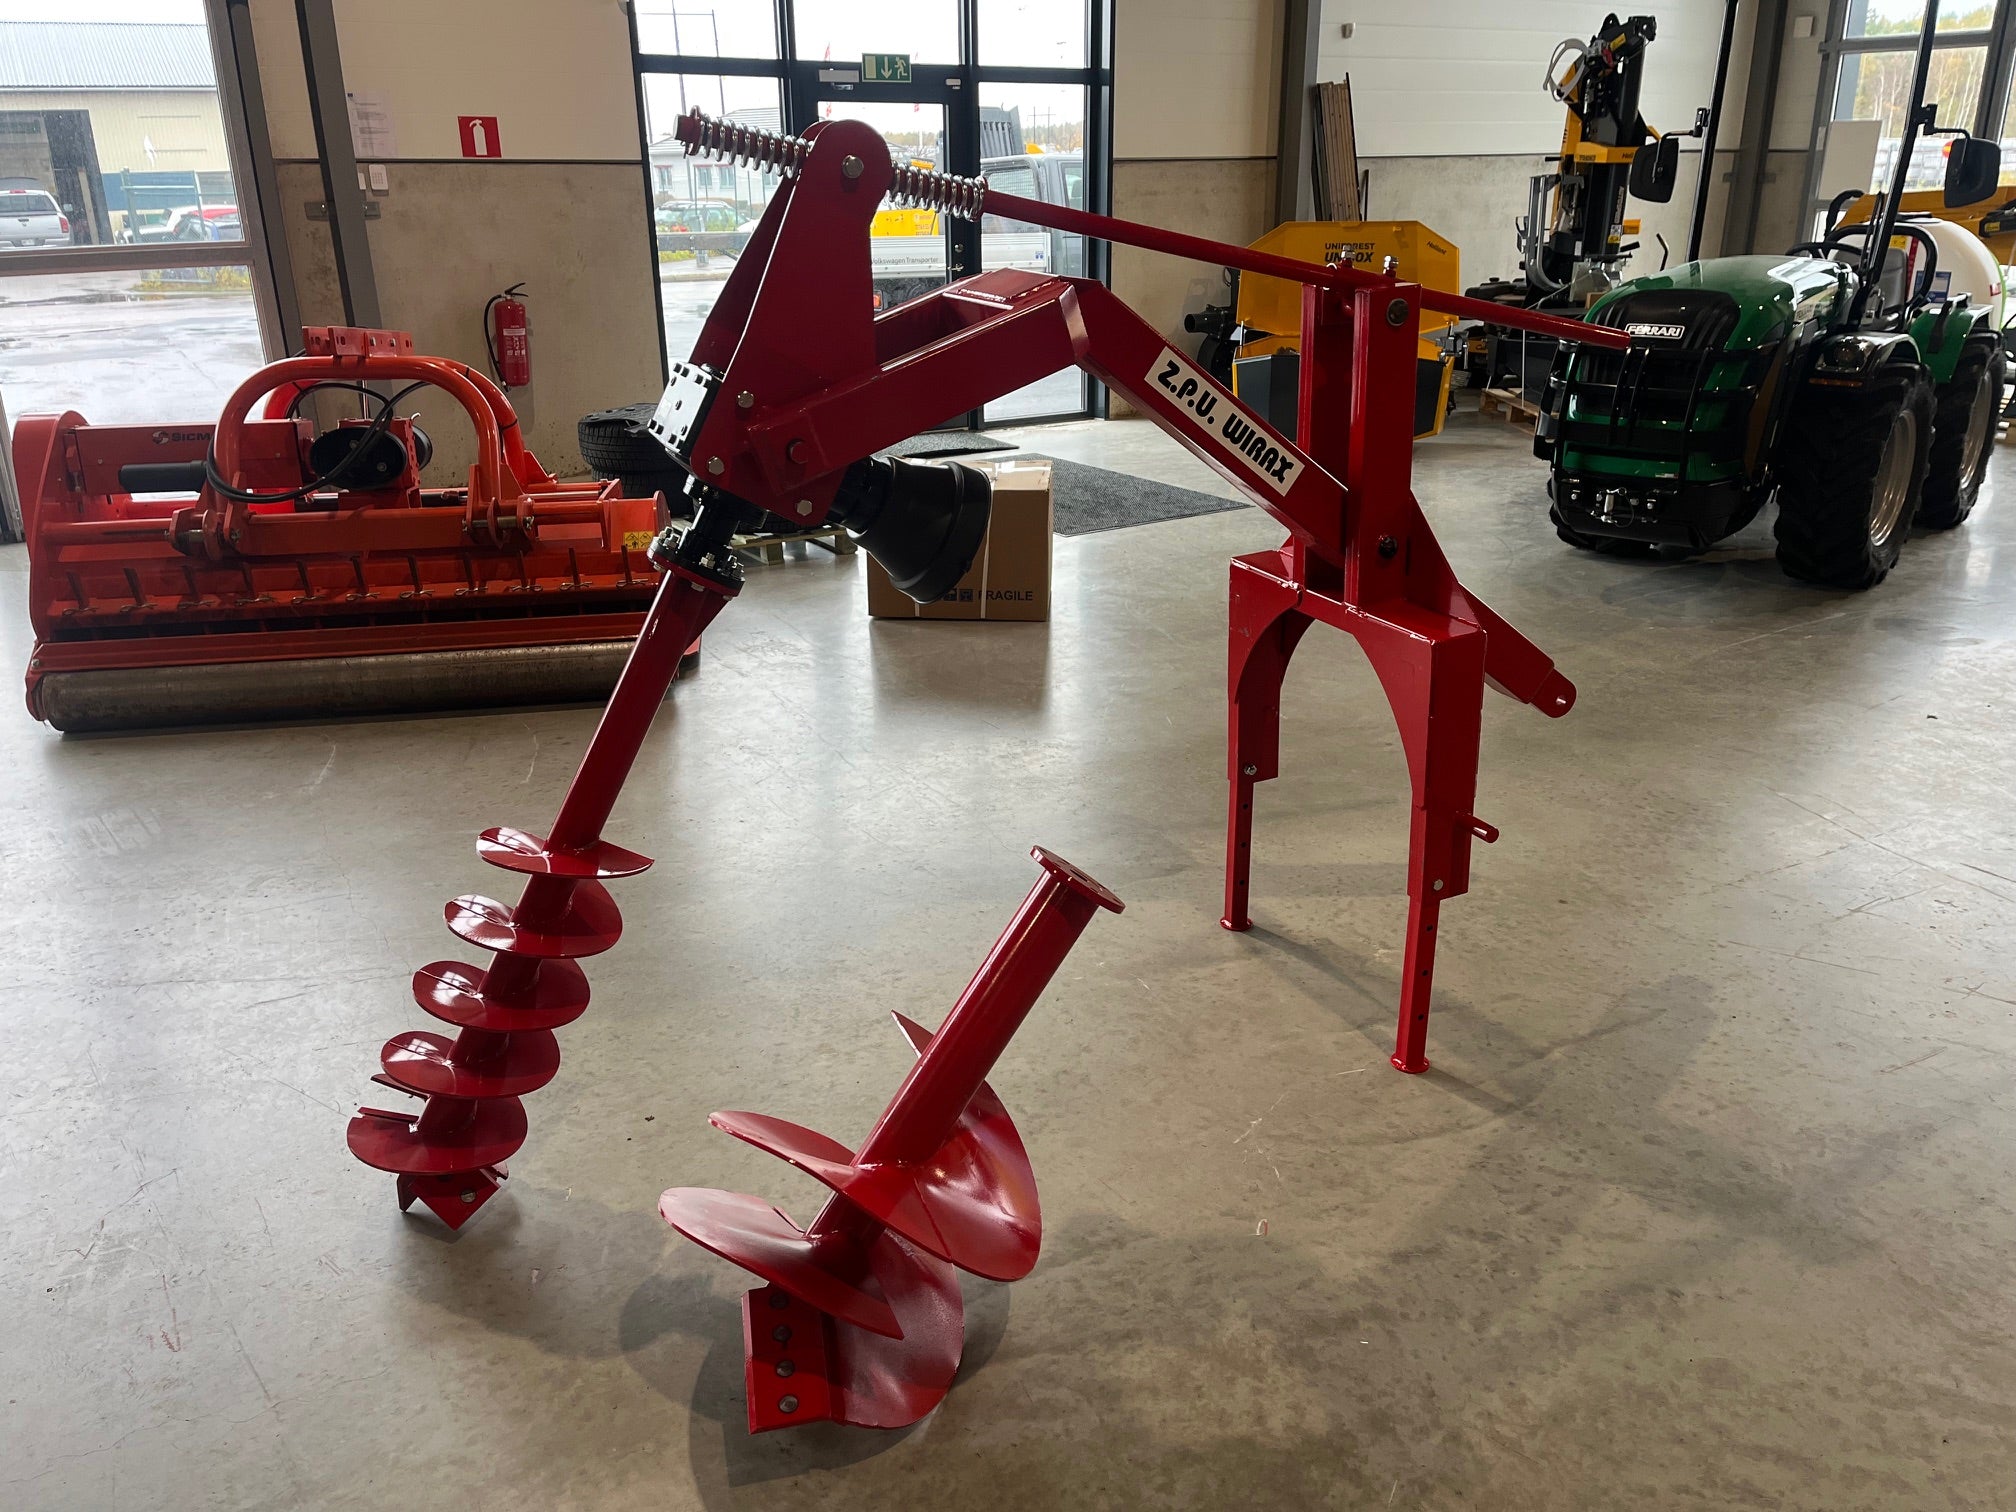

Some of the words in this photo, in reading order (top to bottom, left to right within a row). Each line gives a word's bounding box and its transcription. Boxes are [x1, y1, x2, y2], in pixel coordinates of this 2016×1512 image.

[873, 257, 906, 265] olkswagen
[906, 256, 939, 264] Transporter
[1325, 252, 1374, 262] UNOX
[1628, 325, 1681, 336] FERRARI
[1157, 360, 1218, 425] Z.P.U.
[1222, 412, 1294, 484] WIRAX
